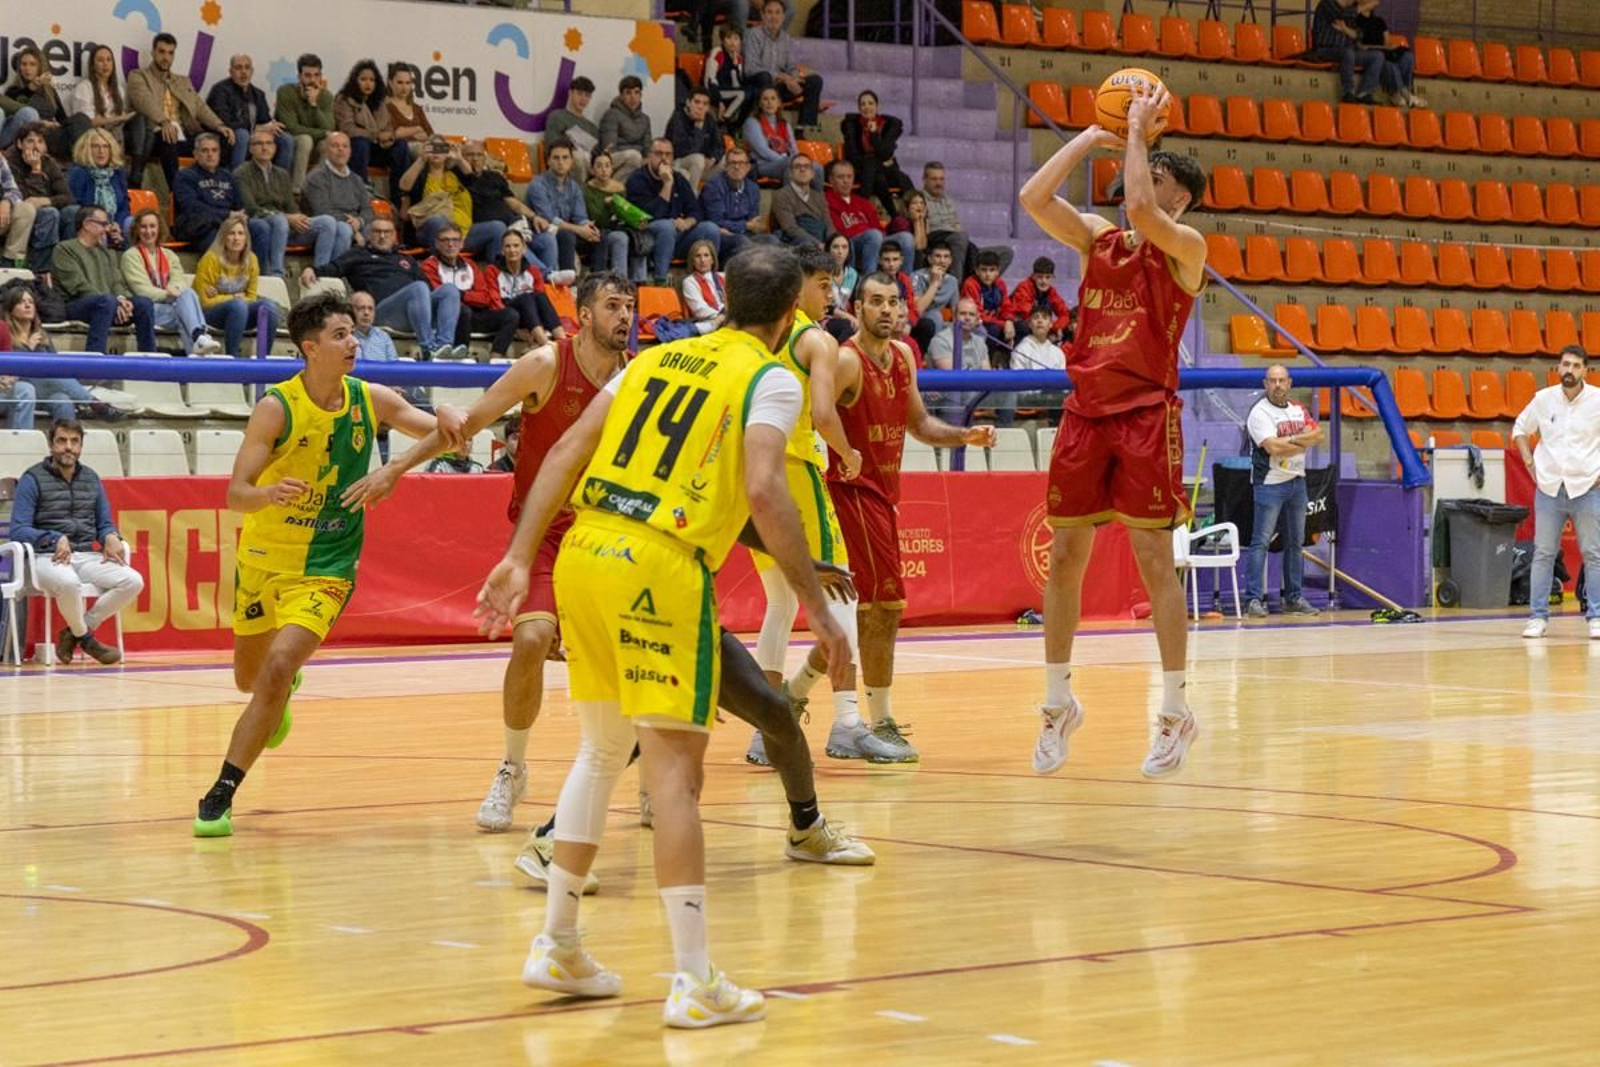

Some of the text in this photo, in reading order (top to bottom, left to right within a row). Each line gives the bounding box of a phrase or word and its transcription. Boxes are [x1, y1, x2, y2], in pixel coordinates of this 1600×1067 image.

[660, 351, 705, 374] DAVID
[611, 376, 710, 482] 14
[1152, 486, 1162, 502] 4
[899, 539, 944, 554] ALORES
